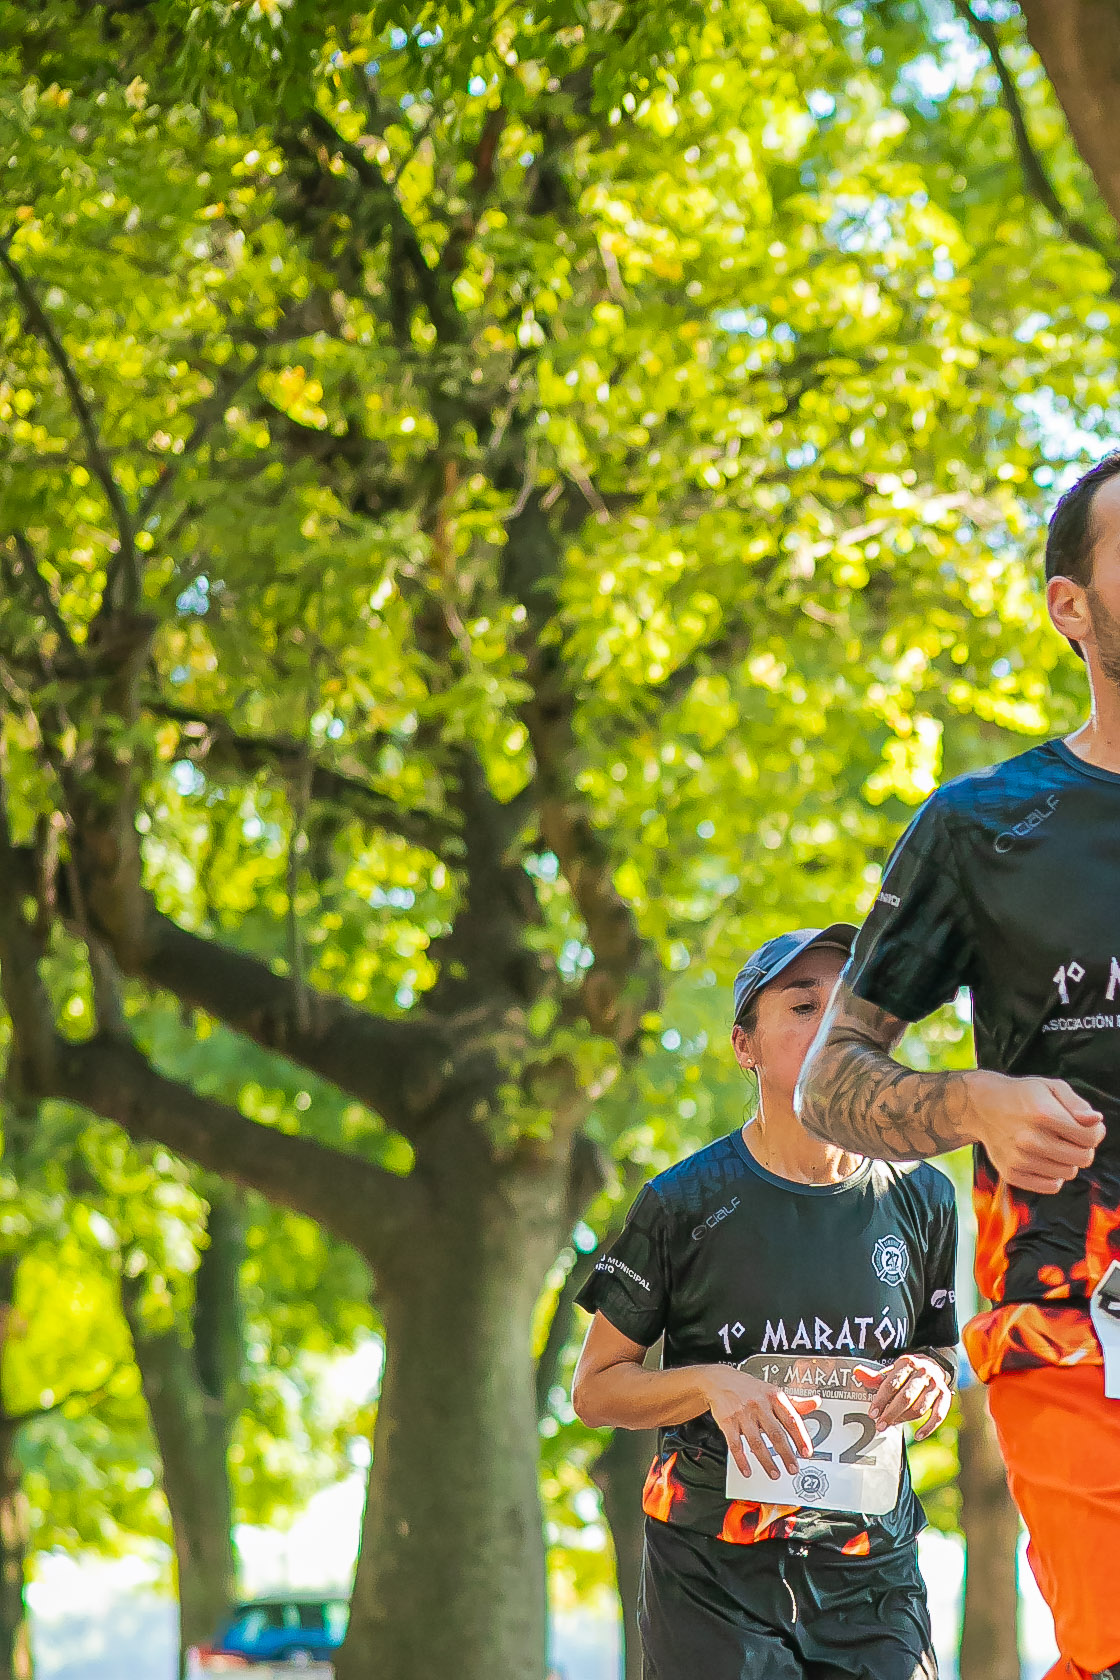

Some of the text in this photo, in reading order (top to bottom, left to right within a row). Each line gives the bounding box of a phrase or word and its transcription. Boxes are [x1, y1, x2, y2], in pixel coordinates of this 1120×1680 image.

[885, 1250, 900, 1267] 27
[607, 1256, 651, 1292] MUNICIPAL
[760, 1305, 908, 1353] MARATÓN
[784, 1386, 821, 1397] BOMBEROS
[821, 1388, 868, 1400] VOLUNTARIOS
[803, 1476, 819, 1489] 27
